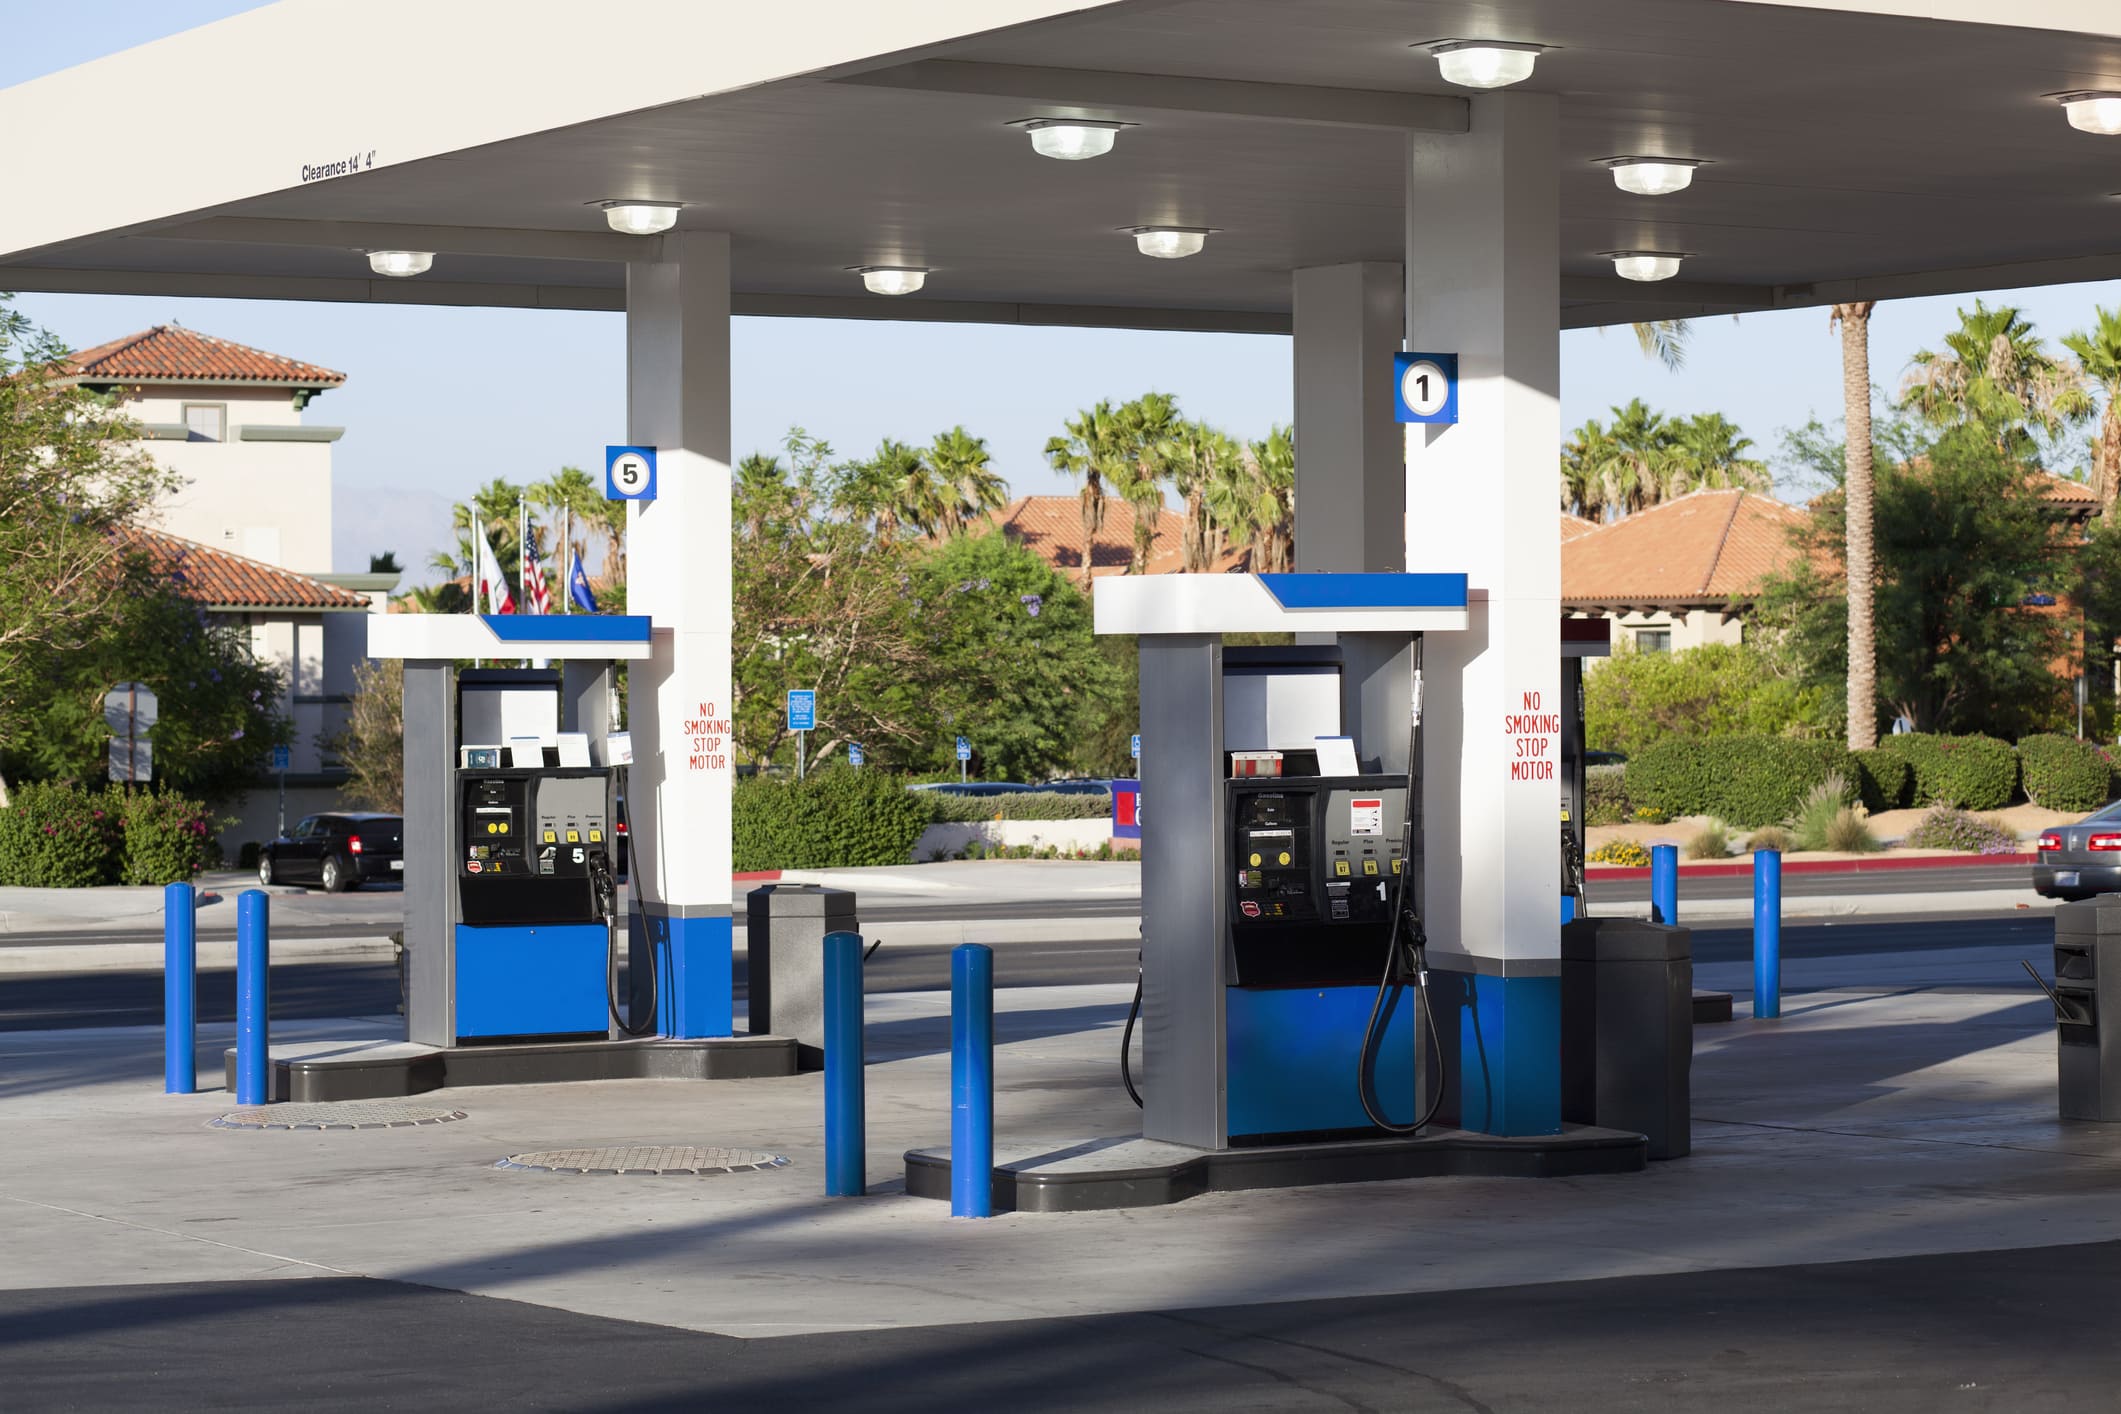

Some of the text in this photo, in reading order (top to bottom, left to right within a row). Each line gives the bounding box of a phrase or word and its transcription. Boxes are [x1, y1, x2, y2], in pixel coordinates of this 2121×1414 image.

[302, 160, 346, 181] Clearance
[1416, 374, 1429, 402] 1
[623, 463, 638, 485] 5
[699, 702, 715, 717] NO
[1523, 691, 1541, 711] NO
[684, 719, 731, 735] SMOKING
[1505, 714, 1560, 735] SMOKING
[693, 737, 721, 753] STOP
[1516, 737, 1549, 758] STOP
[689, 754, 726, 770] MOTOR
[1511, 760, 1554, 781] MOTOR
[572, 847, 585, 864] 5
[1376, 881, 1387, 902] 1
